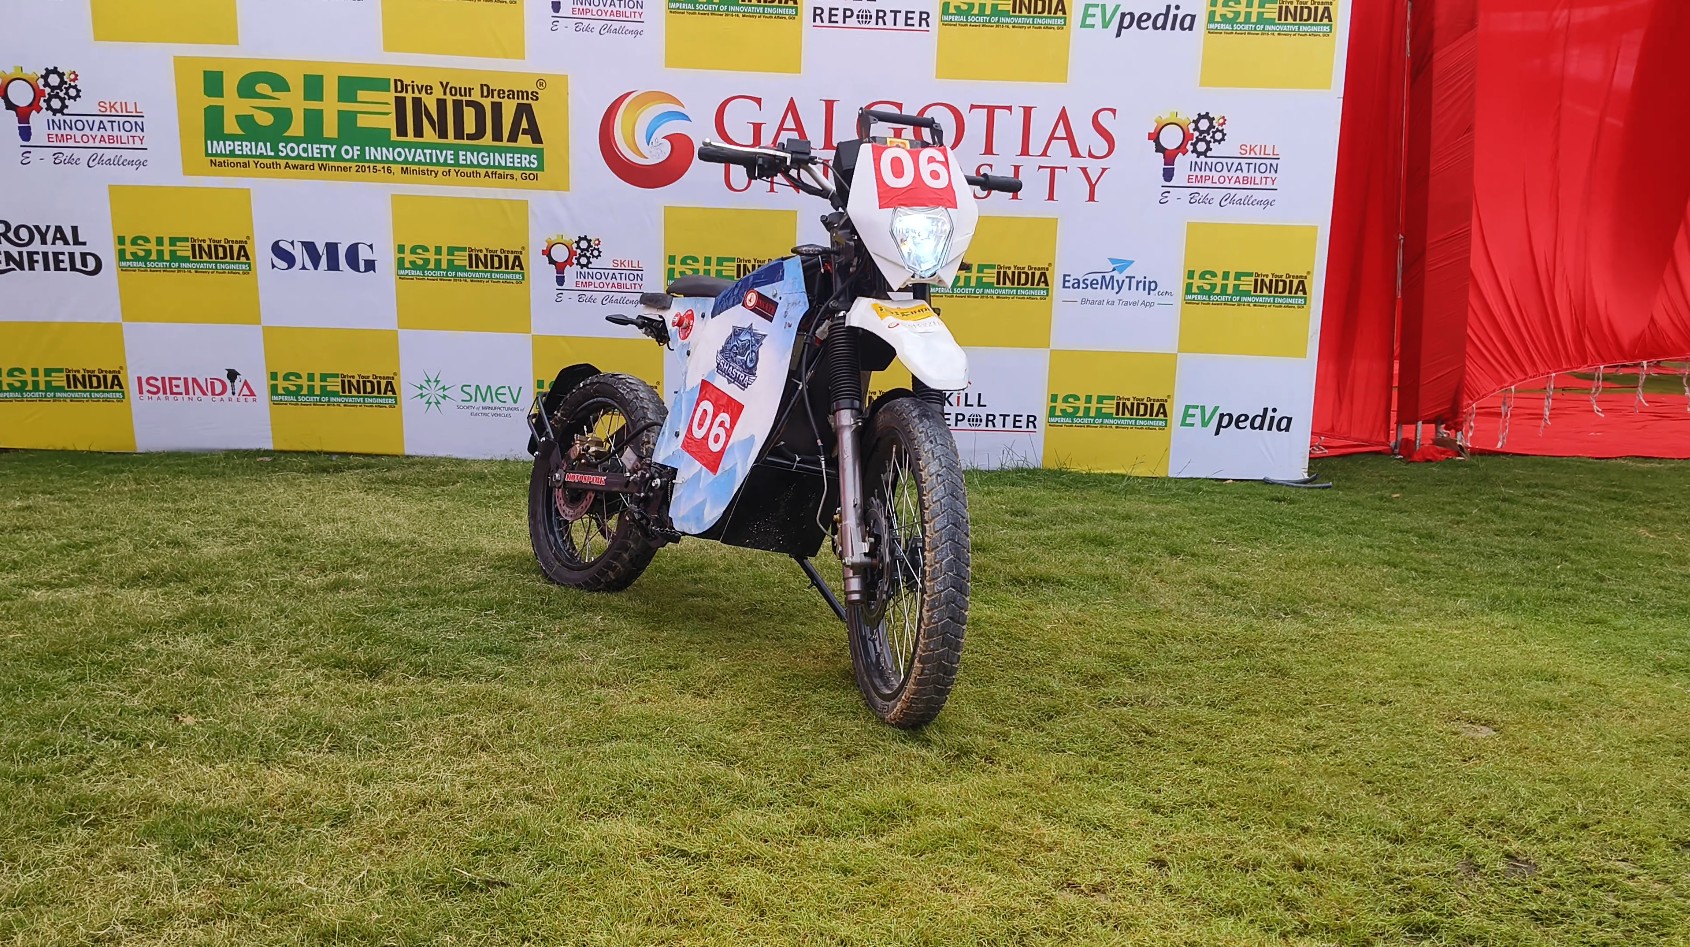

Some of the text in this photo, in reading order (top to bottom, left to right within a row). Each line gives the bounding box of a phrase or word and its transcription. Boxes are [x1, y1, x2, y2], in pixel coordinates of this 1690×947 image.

[572, 0, 644, 10] INNOVATION
[572, 8, 644, 19] EMPLOYABILITY
[1012, 0, 1067, 15] INDIA
[1278, 5, 1333, 22] INDIA
[550, 20, 644, 38] E Bike Challenge
[1080, 3, 1197, 38] EVpedia
[394, 79, 539, 101] Drive Your Dreams
[98, 101, 143, 114] SKILL
[203, 70, 544, 145] ISIE INDIA
[46, 119, 144, 132] INNOVATION
[714, 94, 1118, 160] GALGOTIAS
[47, 134, 145, 144] EMPLOYABILITY
[207, 140, 538, 168] IMPERIAL SOCIETY OF INNOVATIVE ENGINEERS
[1239, 144, 1279, 156] SKILL
[20, 151, 148, 170] E Bike Challenge
[210, 159, 538, 181] National Youth Award Winner 2015-16, Ministry of Youth Affairs, GOI
[880, 147, 950, 189] 06
[1189, 161, 1279, 174] INNOVATION
[1187, 174, 1277, 186] EMPLOYABILITY
[1159, 191, 1276, 210] E Bike Challenge
[0, 220, 87, 248] ROYAL
[117, 235, 250, 261] ISIE INDIA
[270, 239, 378, 274] SMG
[397, 244, 524, 271] ISIE INDIA
[0, 251, 102, 276] NFIELD
[612, 259, 643, 268] SKILL
[576, 271, 643, 281] INNOVATION
[576, 281, 643, 290] EMPLOYABILITY
[996, 270, 1049, 287] INDIA
[1062, 274, 1158, 296] EaseMyTrip
[1185, 270, 1307, 295] ISIE INDIA
[555, 292, 640, 307] E Bike Challeng
[1140, 300, 1155, 308] App
[65, 374, 124, 390] INDIA
[270, 372, 397, 395] ISIE INDIA
[460, 384, 522, 404] SMEV
[1048, 394, 1168, 418] ISIE INDIA
[691, 399, 731, 453] 06
[944, 413, 1037, 429] EPORTER
[1180, 404, 1293, 436] EVpedia
